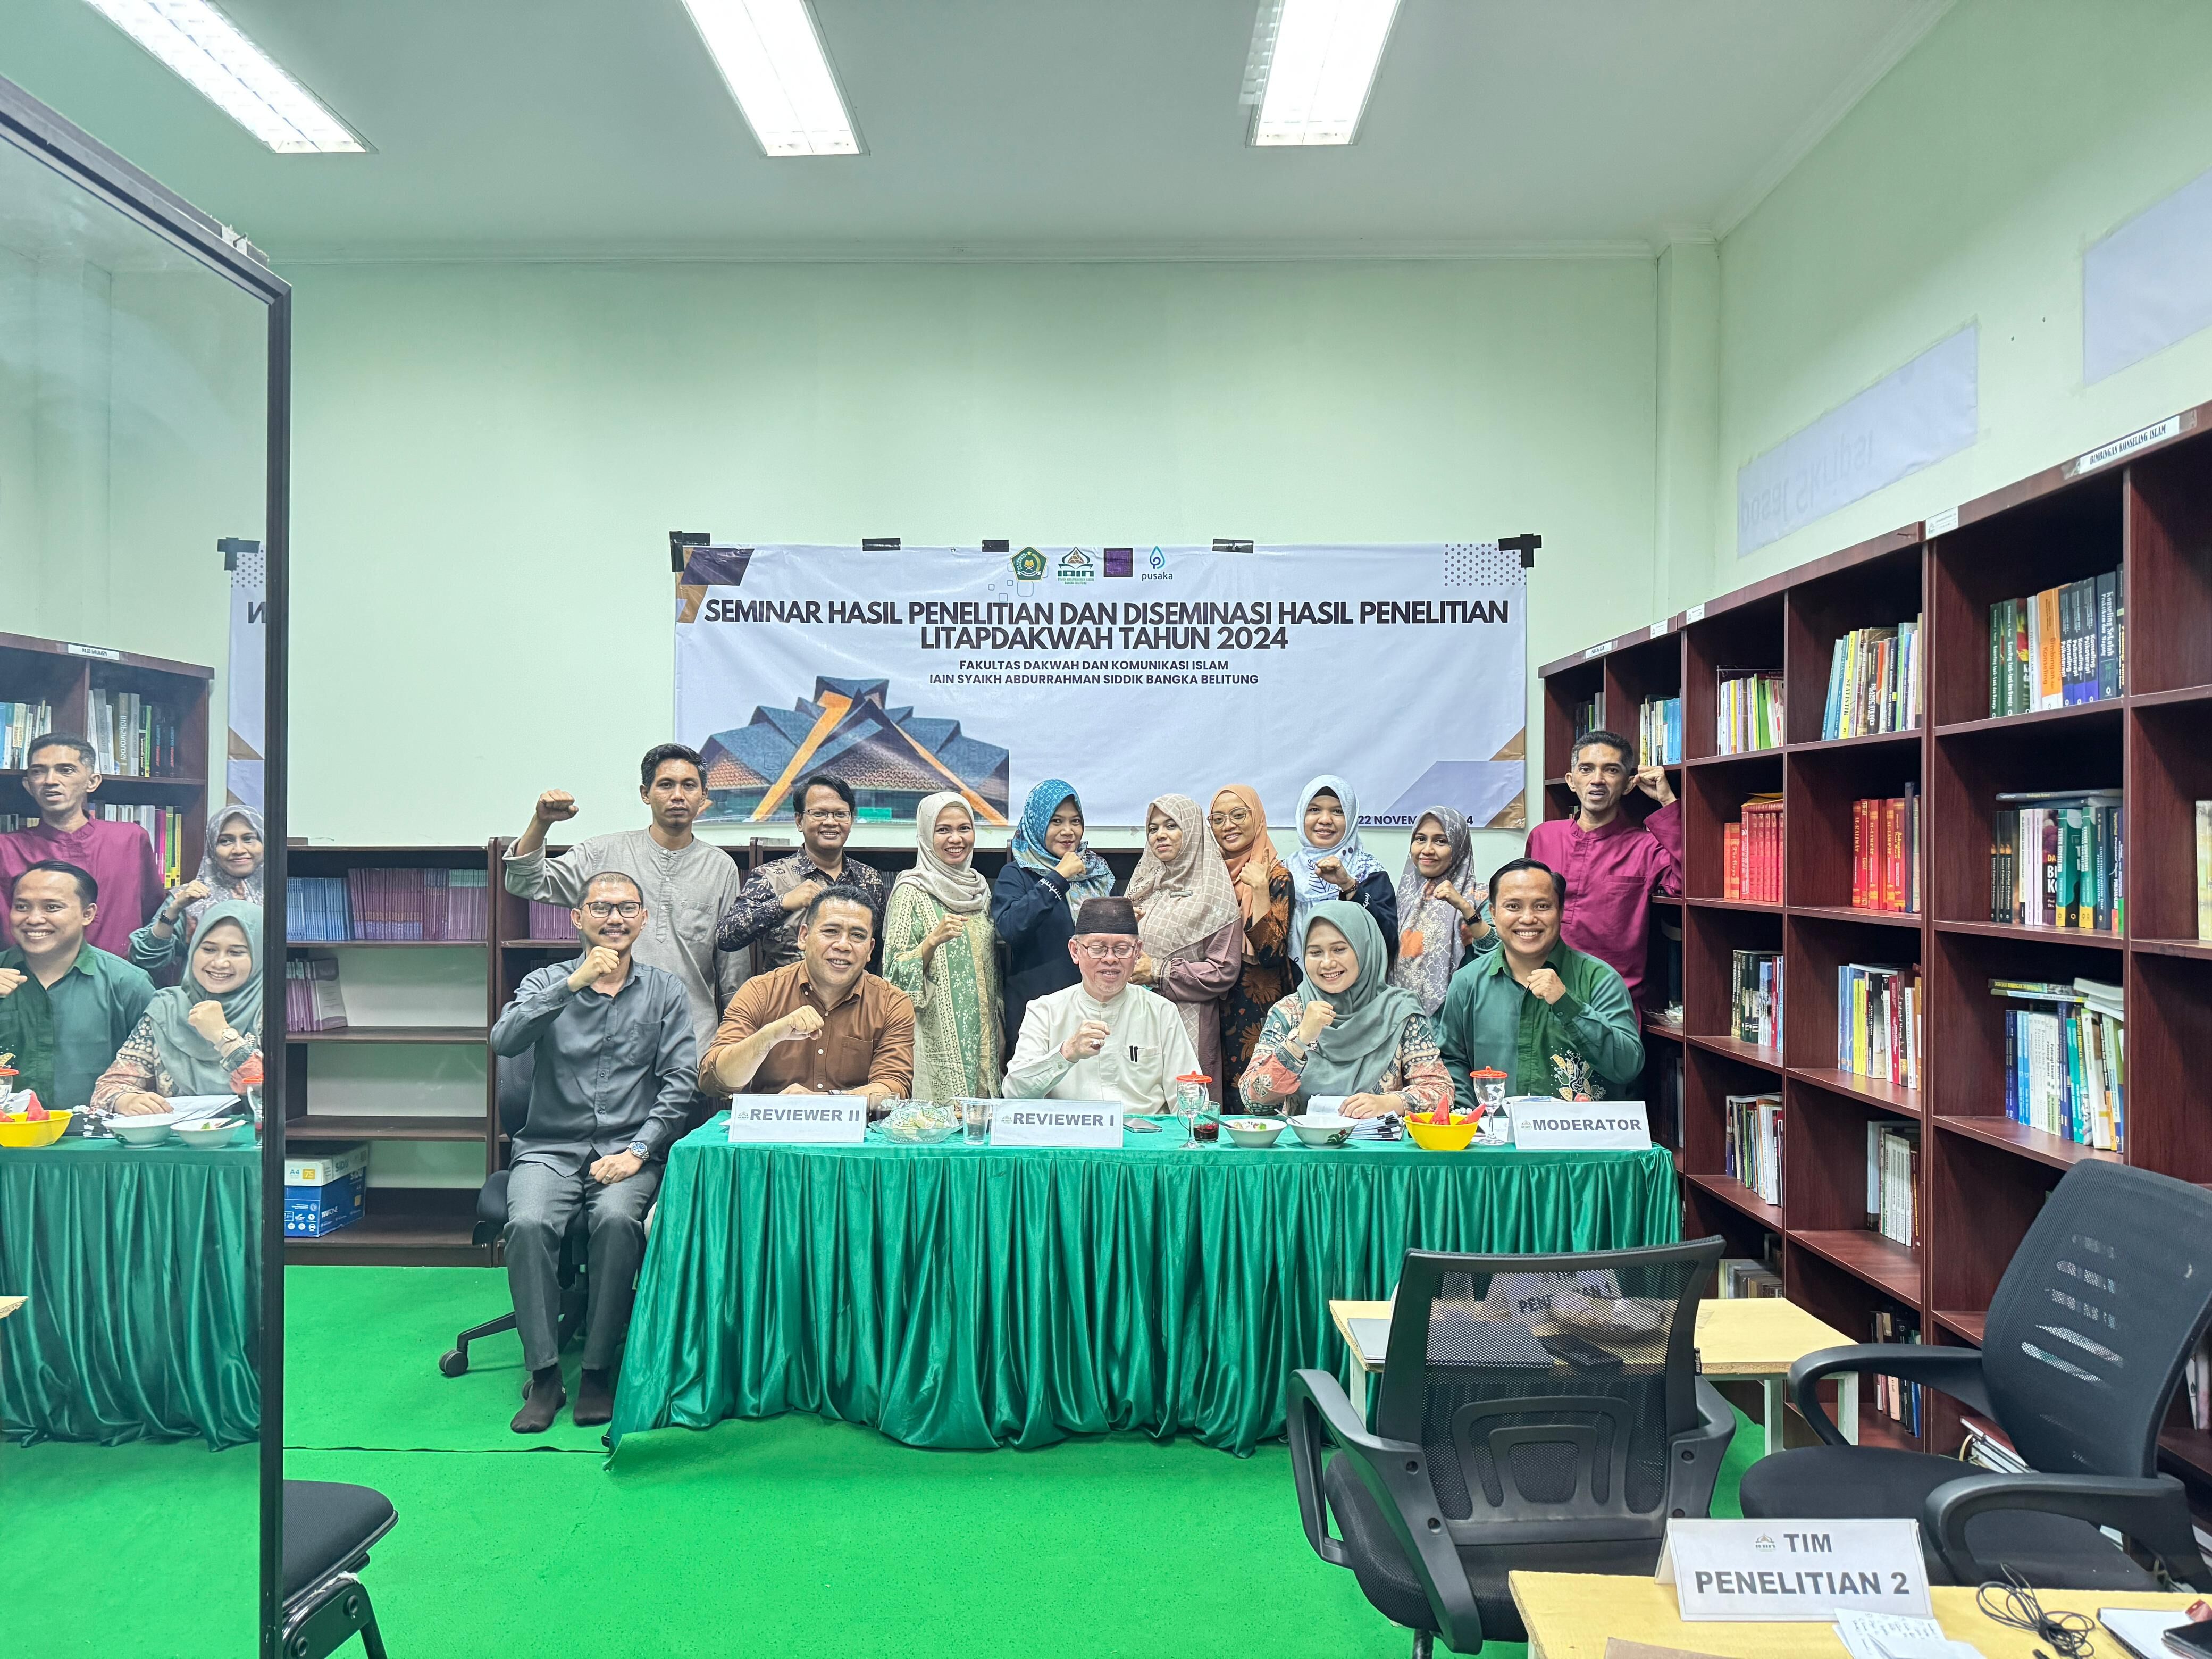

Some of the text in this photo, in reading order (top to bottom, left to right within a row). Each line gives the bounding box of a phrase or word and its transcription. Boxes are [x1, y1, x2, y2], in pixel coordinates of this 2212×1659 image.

[2090, 424, 2166, 465] BIMBINGAN KONSELING ISLAM
[1142, 572, 1173, 581] pusaka
[705, 599, 1508, 625] SEMINAR HASIL PENELITIAN DAN DISEMINASI HASIL PENELITIAN
[921, 627, 1288, 649] LITAPDAKWAH TAHUN 2024
[960, 660, 1228, 670] FAKULTAS DAKWAH DAN KOMUNIKASI ISLAM
[930, 675, 1258, 684] IAIN SYAIKH ABDURRAHMAN SIDDIK BANGKA BELITUNG
[1358, 815, 1418, 824] 22 NOVEM
[750, 1109, 859, 1121] REVIEWER II
[1013, 1113, 1114, 1126] REVIEWER I
[1533, 1119, 1641, 1130] MODERATOR
[1784, 1534, 1832, 1552] TIM
[1695, 1571, 1909, 1594] PENELITIAN 2
